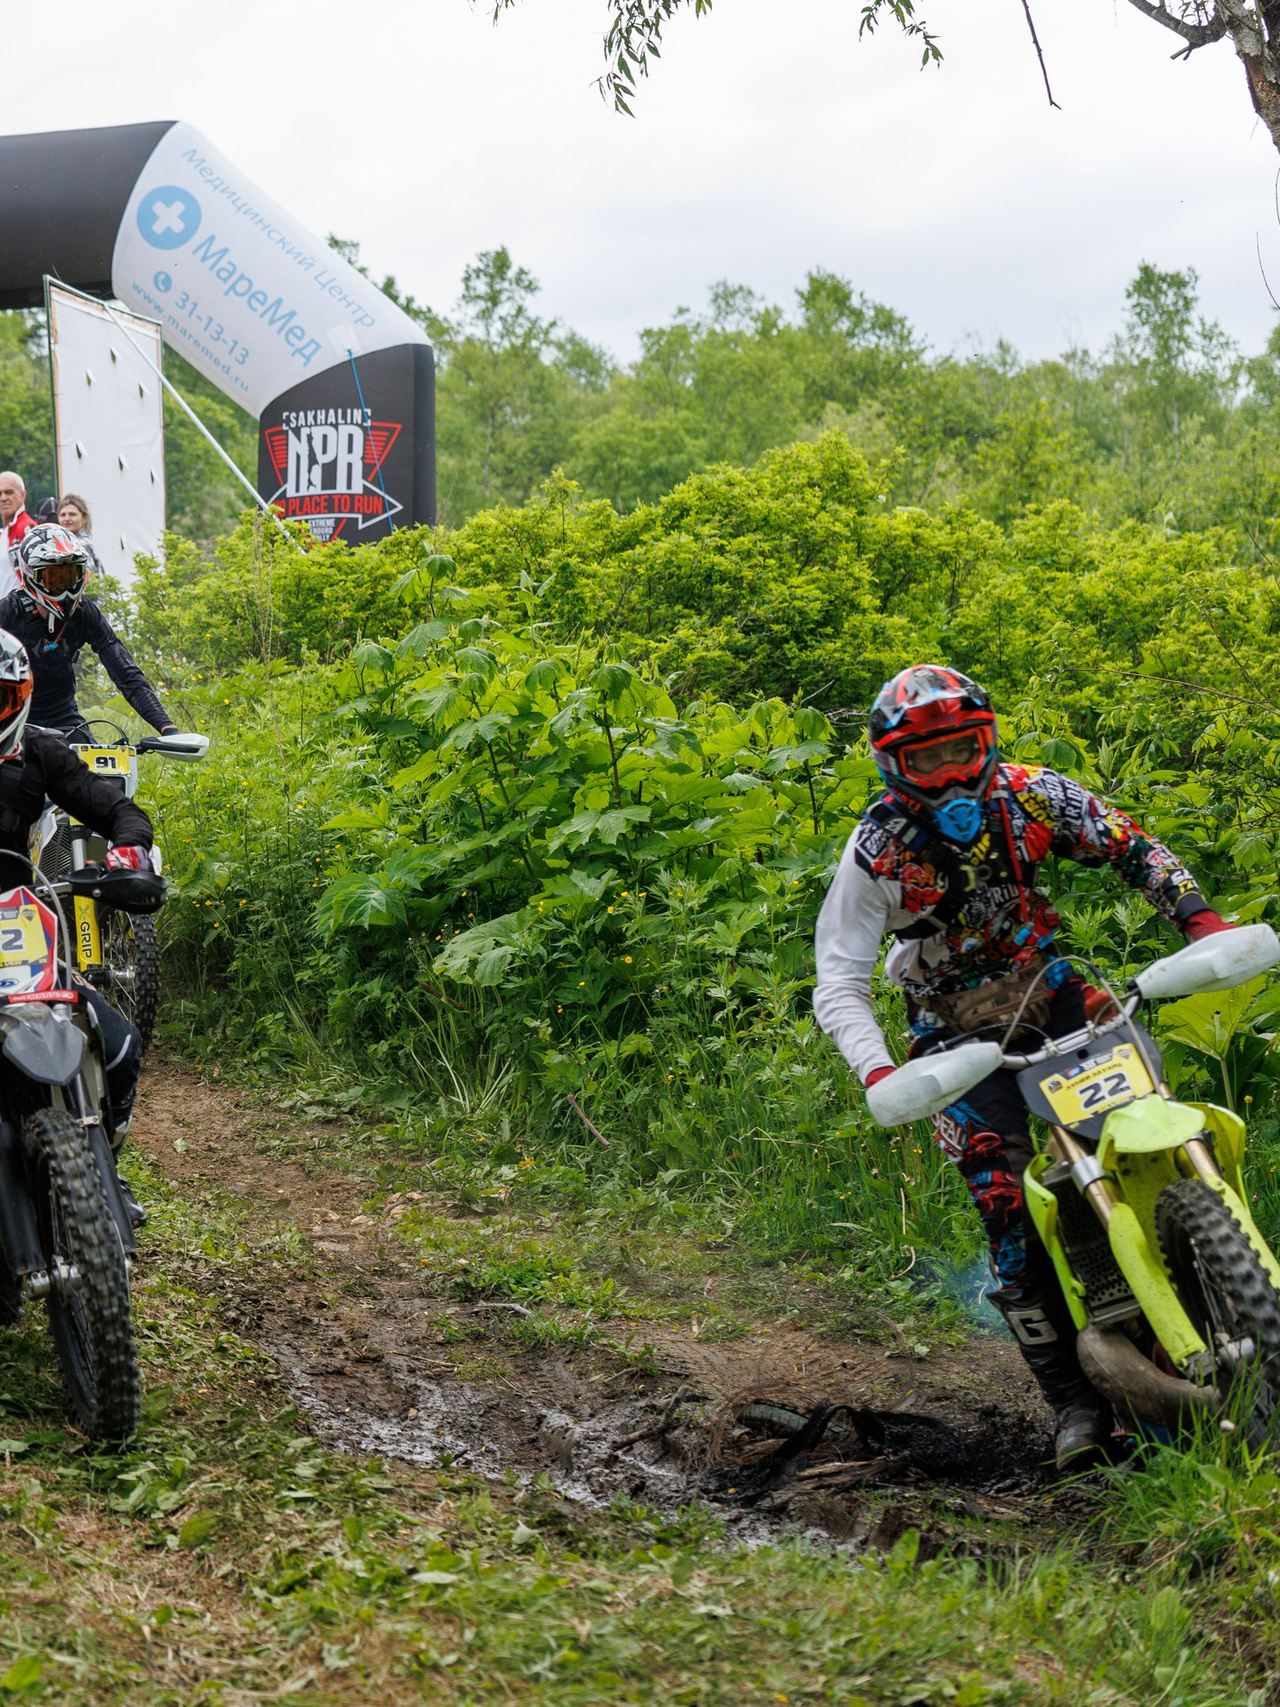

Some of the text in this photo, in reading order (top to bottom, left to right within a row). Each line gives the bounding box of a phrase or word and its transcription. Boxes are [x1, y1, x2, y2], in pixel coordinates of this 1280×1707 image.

[182, 149, 376, 328] Медицинский Центр
[132, 281, 249, 393] www.maremed.ru
[175, 292, 250, 365] 31-13-13
[192, 234, 322, 368] МареМед
[289, 408, 363, 428] SAKHALIN
[286, 423, 365, 498] NPR
[288, 495, 329, 517] PLACE
[332, 494, 351, 513] TO
[353, 494, 383, 515] RUN
[95, 756, 117, 769] 91
[1078, 1072, 1131, 1109] 22
